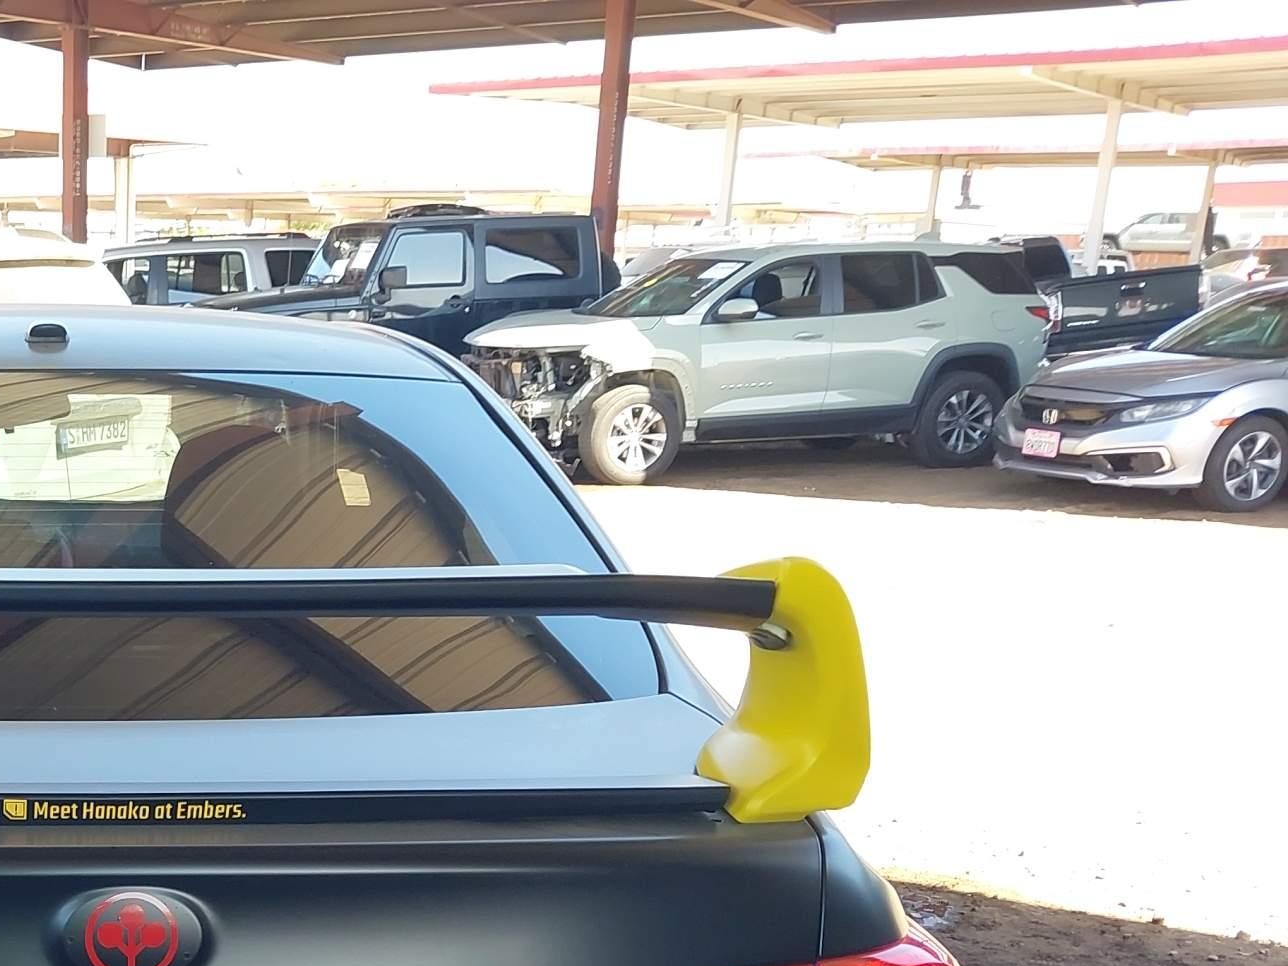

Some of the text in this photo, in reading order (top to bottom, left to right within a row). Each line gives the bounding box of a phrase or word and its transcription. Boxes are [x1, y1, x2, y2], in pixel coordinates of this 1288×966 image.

[34, 800, 246, 819] Meet Hanako at Embers.
